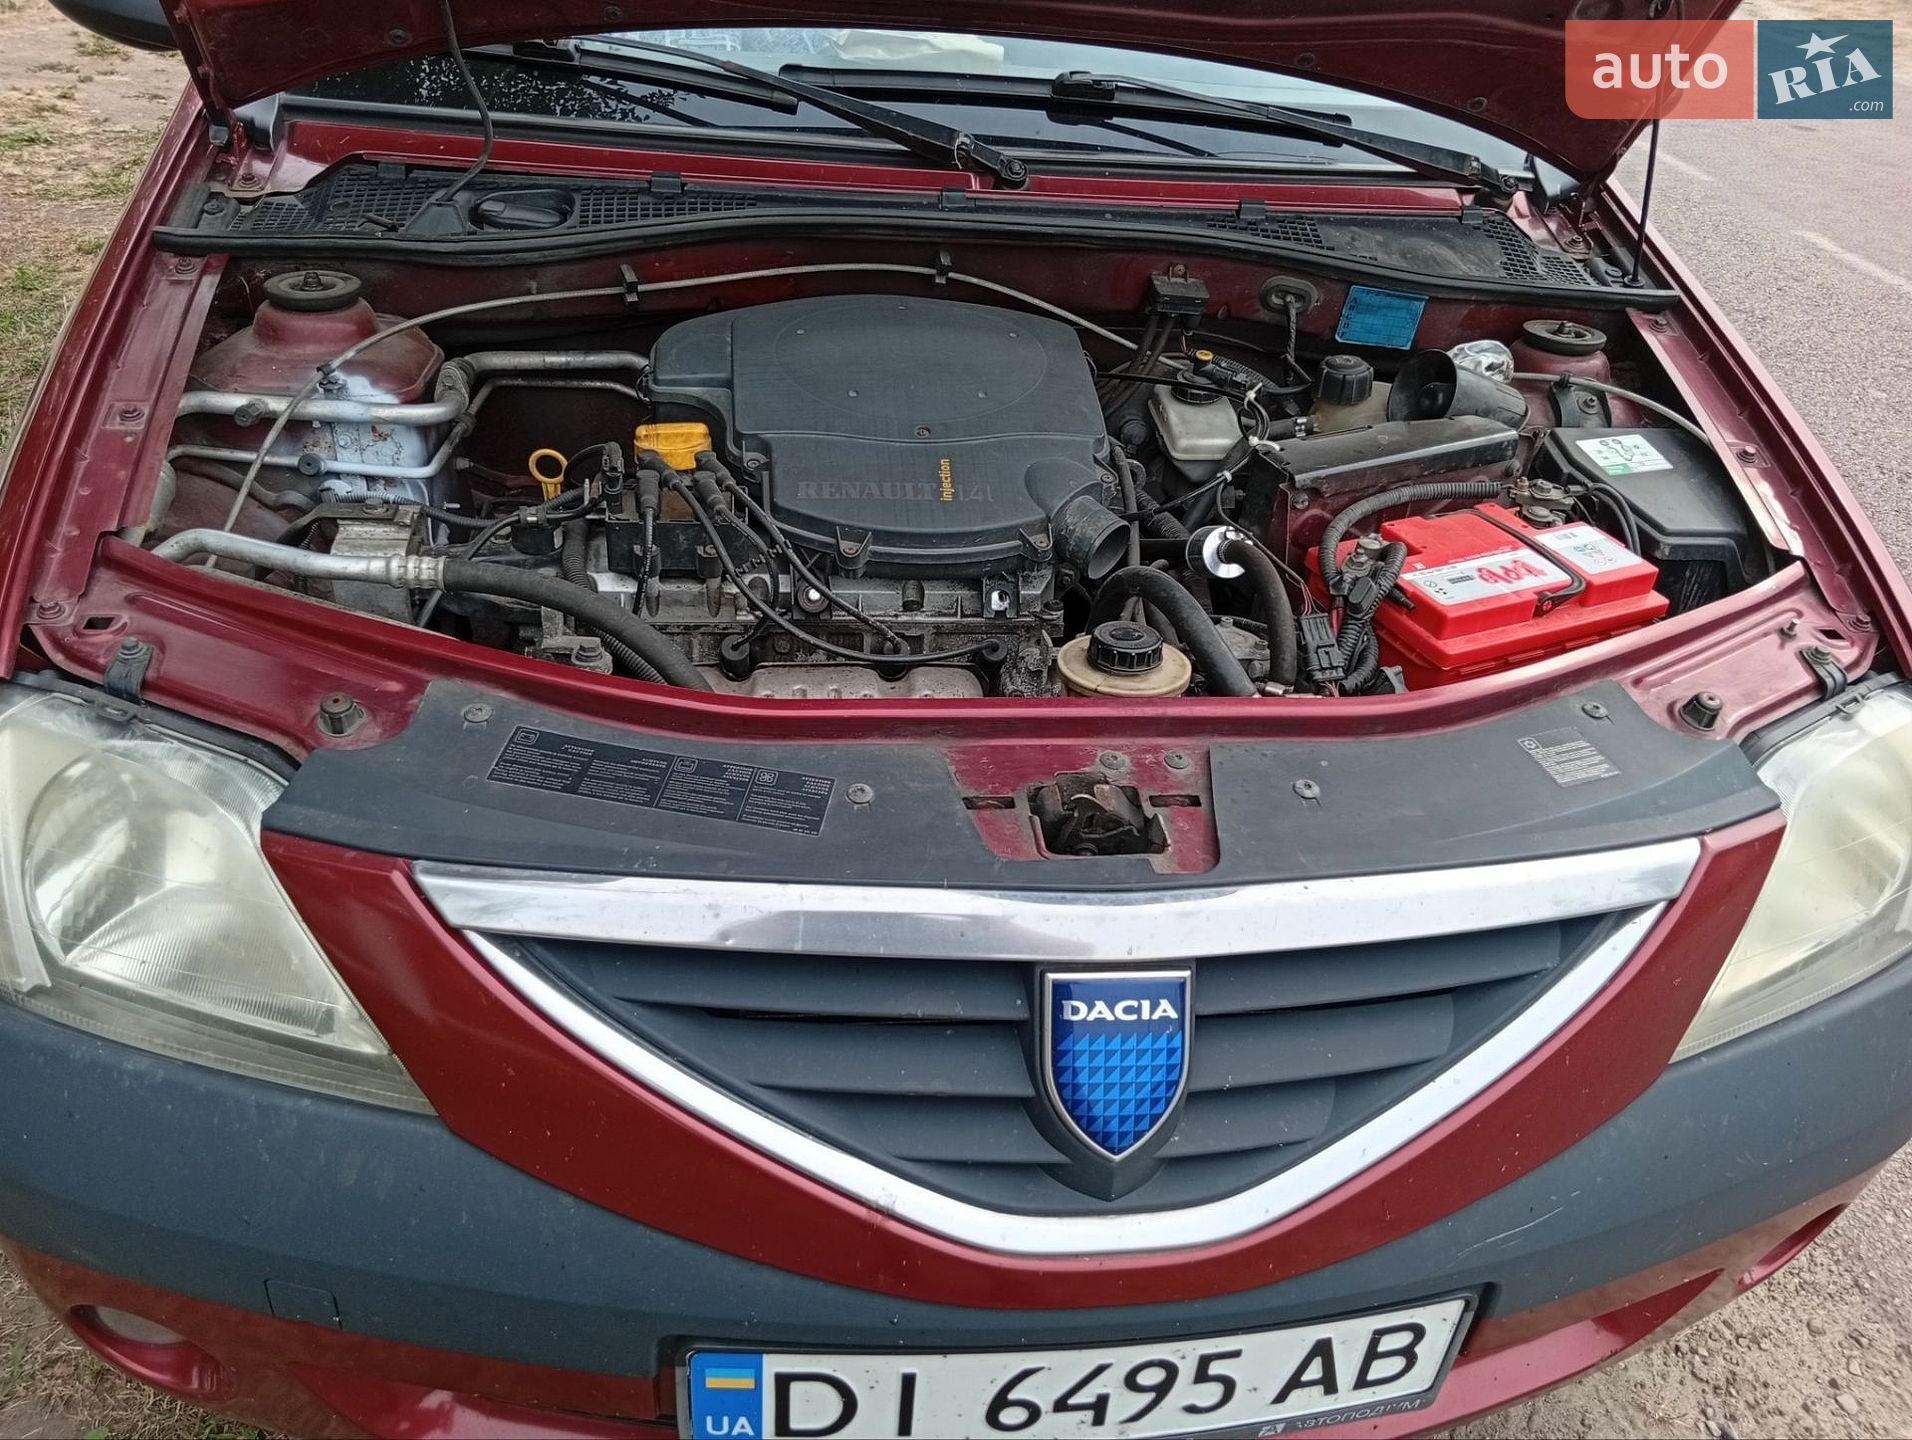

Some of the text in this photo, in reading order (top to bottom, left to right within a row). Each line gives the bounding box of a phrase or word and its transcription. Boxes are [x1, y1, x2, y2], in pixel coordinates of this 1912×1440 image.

[939, 458, 955, 501] injection
[797, 481, 937, 501] RENAULT
[1062, 999, 1178, 1021] DACIA
[984, 1348, 1243, 1432] 6495
[1270, 1321, 1427, 1405] AB
[706, 1415, 755, 1436] UA
